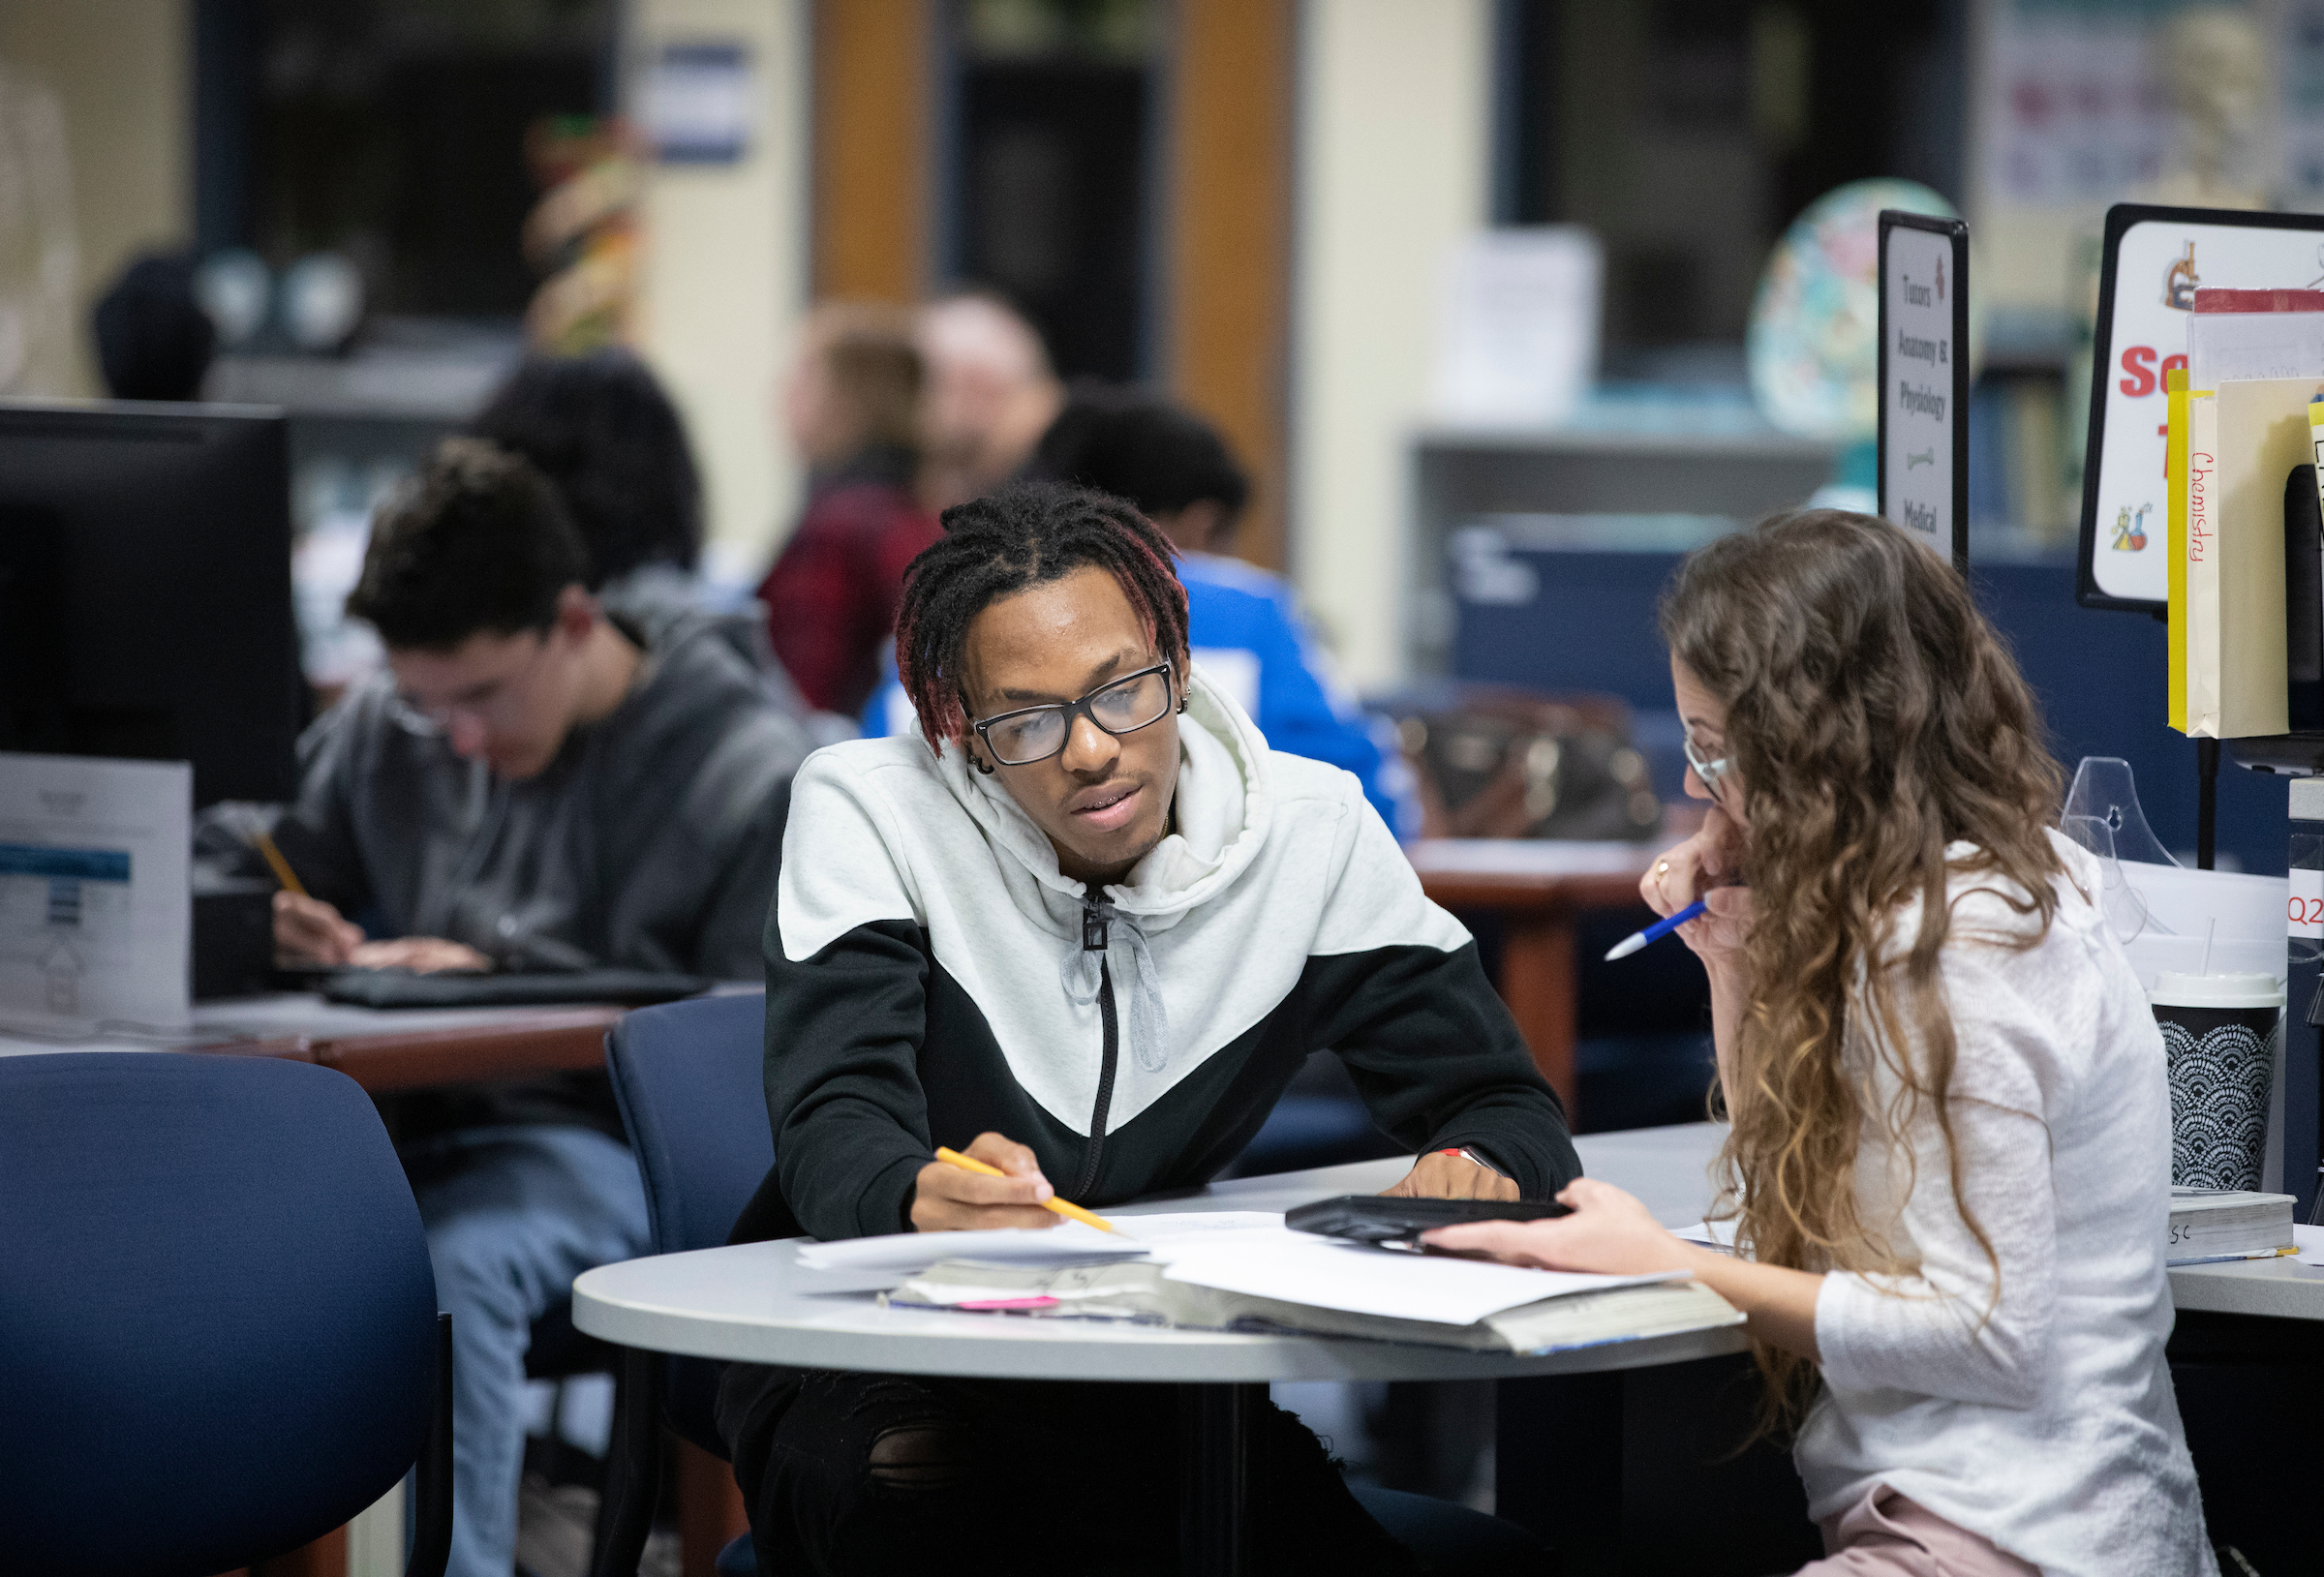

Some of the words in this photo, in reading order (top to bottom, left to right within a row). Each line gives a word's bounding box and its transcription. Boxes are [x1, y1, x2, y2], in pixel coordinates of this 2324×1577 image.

[1902, 273, 1932, 309] Tutors
[1898, 327, 1937, 368] Anatomy
[1939, 338, 1948, 365] &
[1900, 379, 1946, 423] Physiology
[1904, 498, 1937, 534] Medical
[2188, 452, 2214, 561] Chemistry
[2287, 896, 2324, 925] Q2
